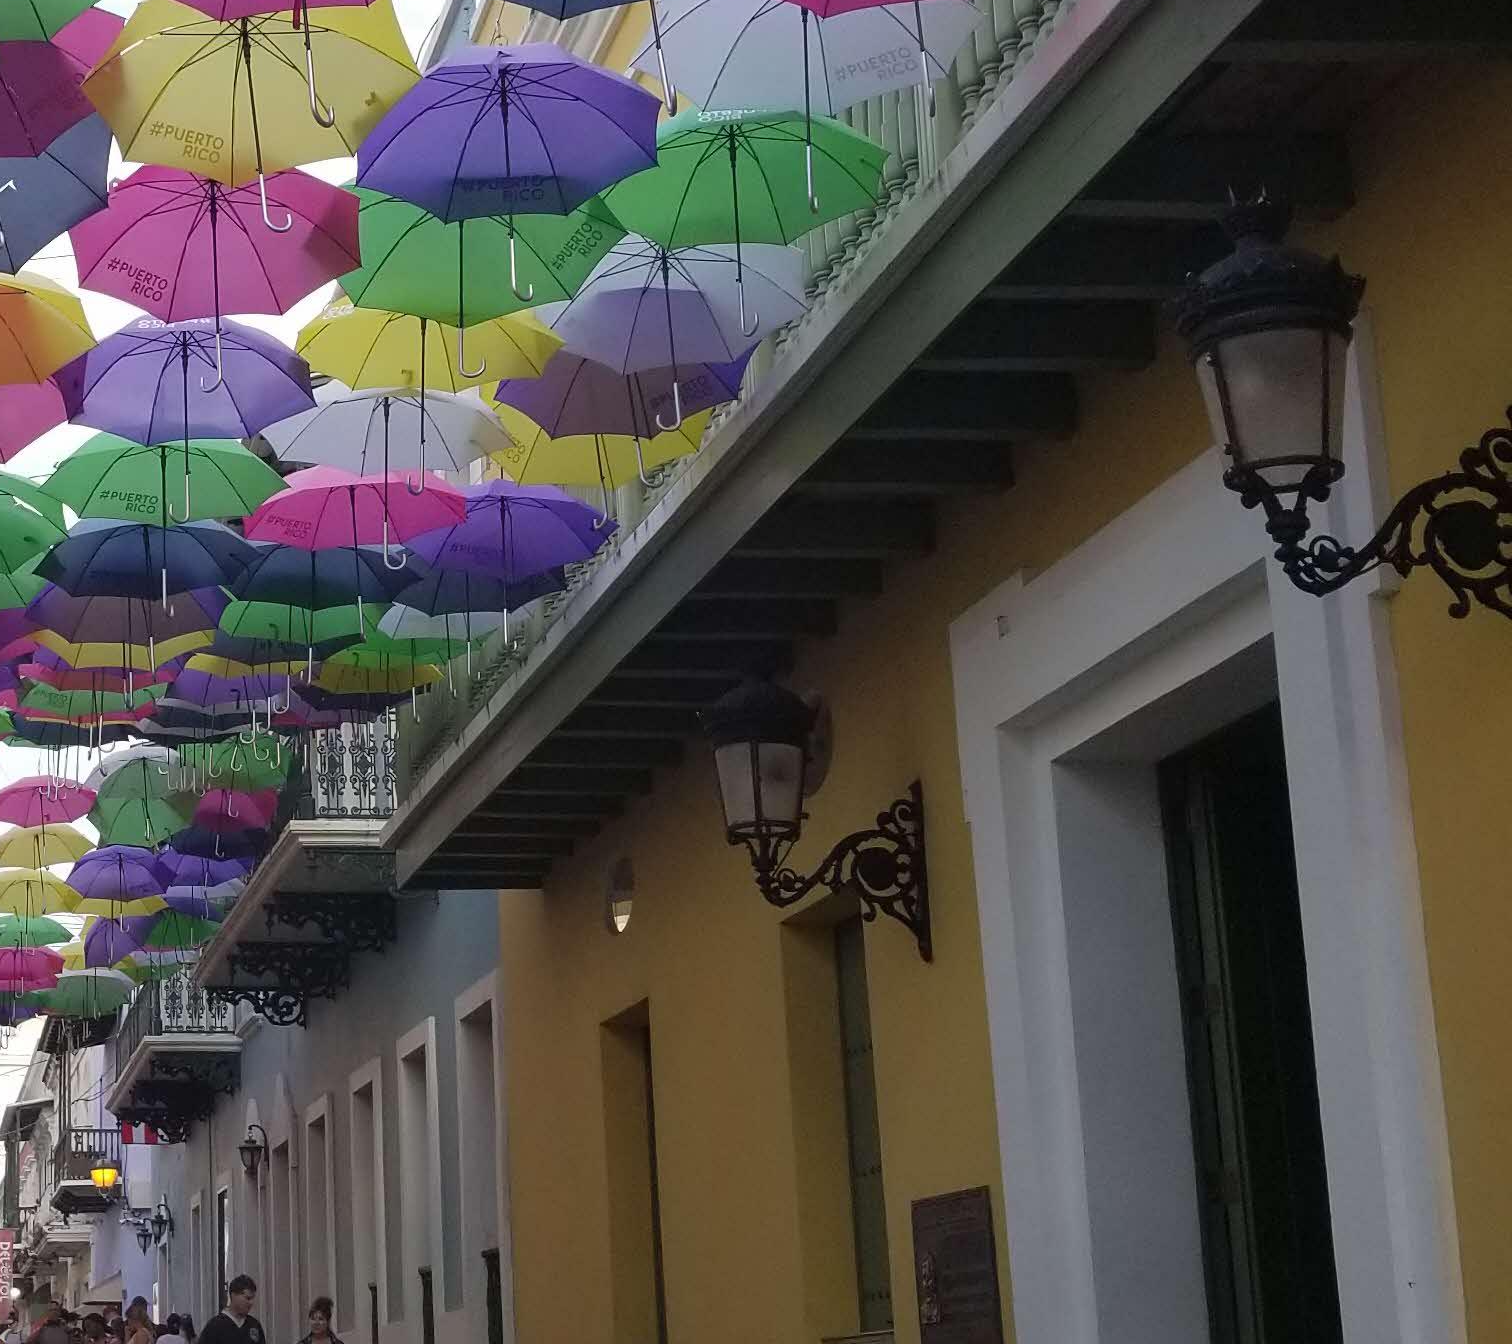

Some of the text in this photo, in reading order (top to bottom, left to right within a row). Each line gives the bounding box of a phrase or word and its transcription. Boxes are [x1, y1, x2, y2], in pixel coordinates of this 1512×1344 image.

[834, 47, 912, 82] #PUERTO
[878, 59, 918, 82] RICO
[150, 120, 224, 150] #PUERTO
[183, 144, 220, 164] RICO
[551, 222, 593, 270] #PUERTO
[578, 229, 603, 257] RICO
[107, 256, 168, 290] #PUERTO
[130, 281, 163, 302] RICO
[99, 490, 158, 506] #PUERTO
[125, 502, 156, 515] RICO
